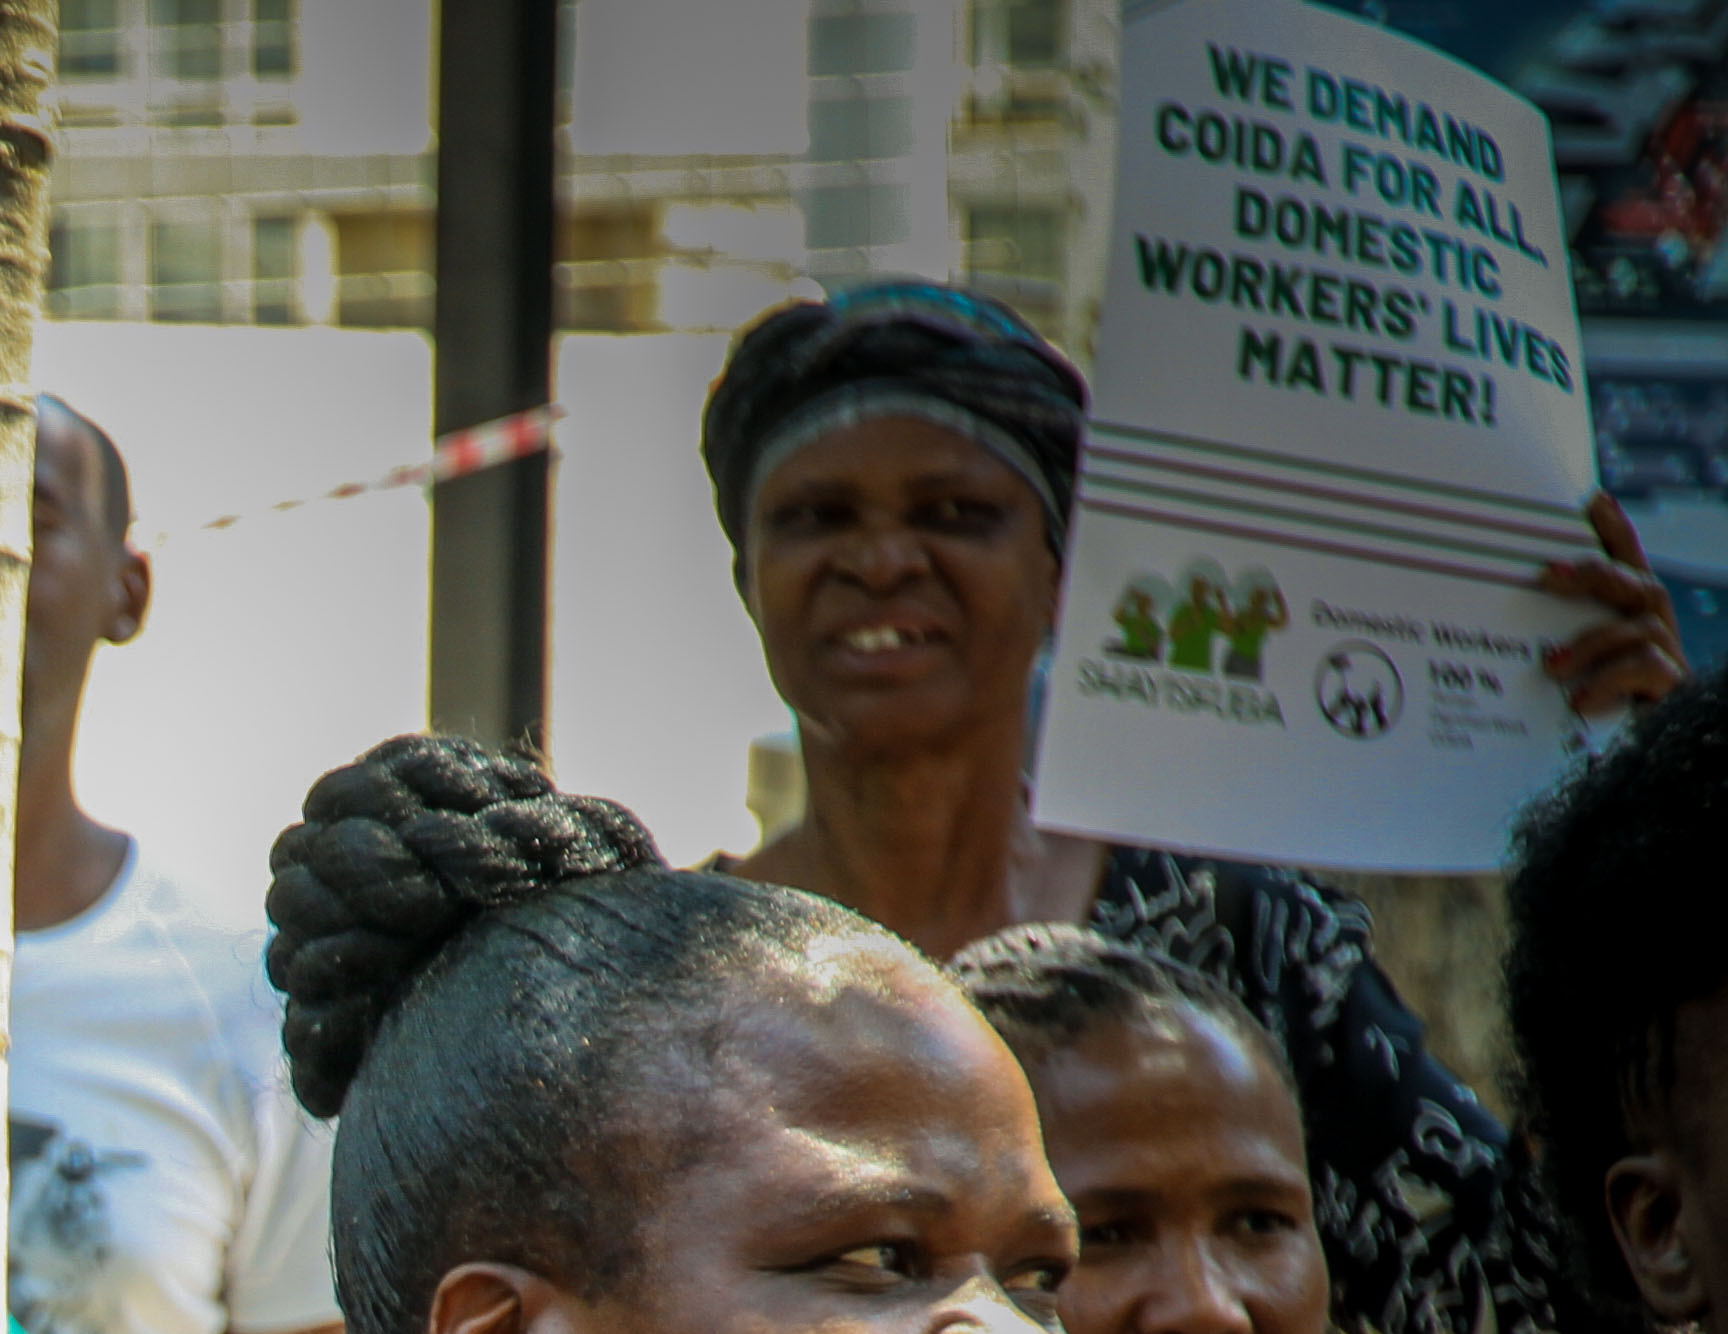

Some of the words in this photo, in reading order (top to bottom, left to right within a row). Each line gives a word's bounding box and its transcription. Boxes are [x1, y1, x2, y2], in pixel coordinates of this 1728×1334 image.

[1155, 104, 1326, 184] COIDA
[1342, 149, 1441, 216] FOR
[1205, 44, 1292, 108] WE
[1306, 69, 1505, 182] DEMAND
[1234, 186, 1502, 299] DOMESTIC
[1135, 234, 1432, 340] WORKERS'
[1443, 303, 1576, 395] LIVES
[1237, 328, 1500, 428] MATTER!
